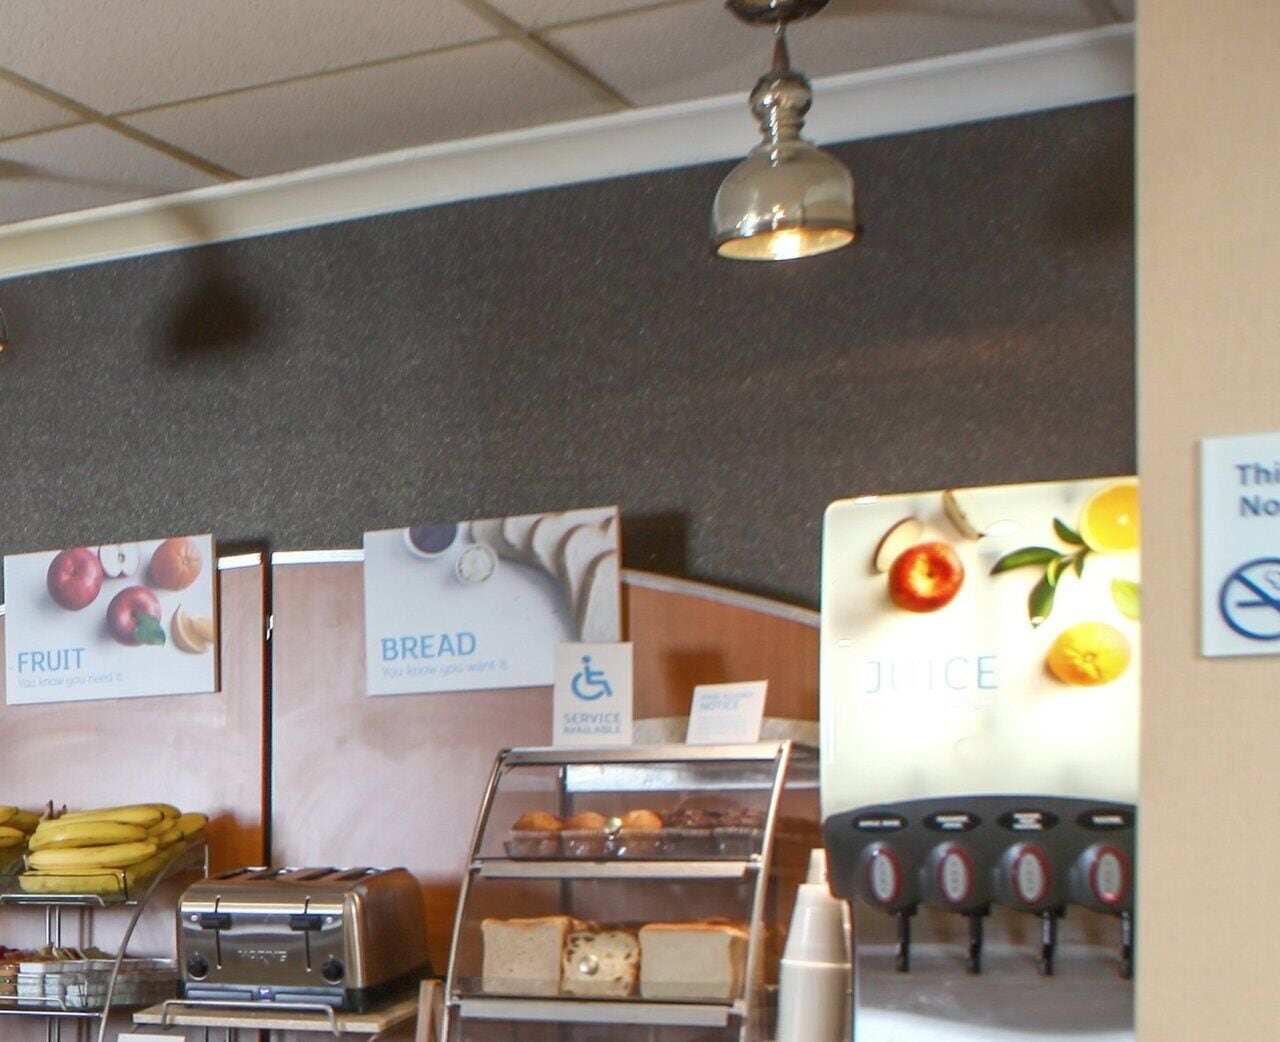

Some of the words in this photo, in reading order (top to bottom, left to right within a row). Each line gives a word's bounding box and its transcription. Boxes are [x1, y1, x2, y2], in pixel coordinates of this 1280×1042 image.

[381, 632, 477, 661] BREAD
[17, 647, 86, 673] FRUIT
[406, 665, 438, 675] know
[441, 665, 464, 677] you
[865, 656, 999, 694] JUICE
[18, 679, 35, 688] You
[39, 676, 64, 686] know
[66, 677, 85, 688] you
[88, 672, 112, 683] need
[563, 712, 621, 724] SERVICE
[562, 725, 621, 735] AVAILABLE
